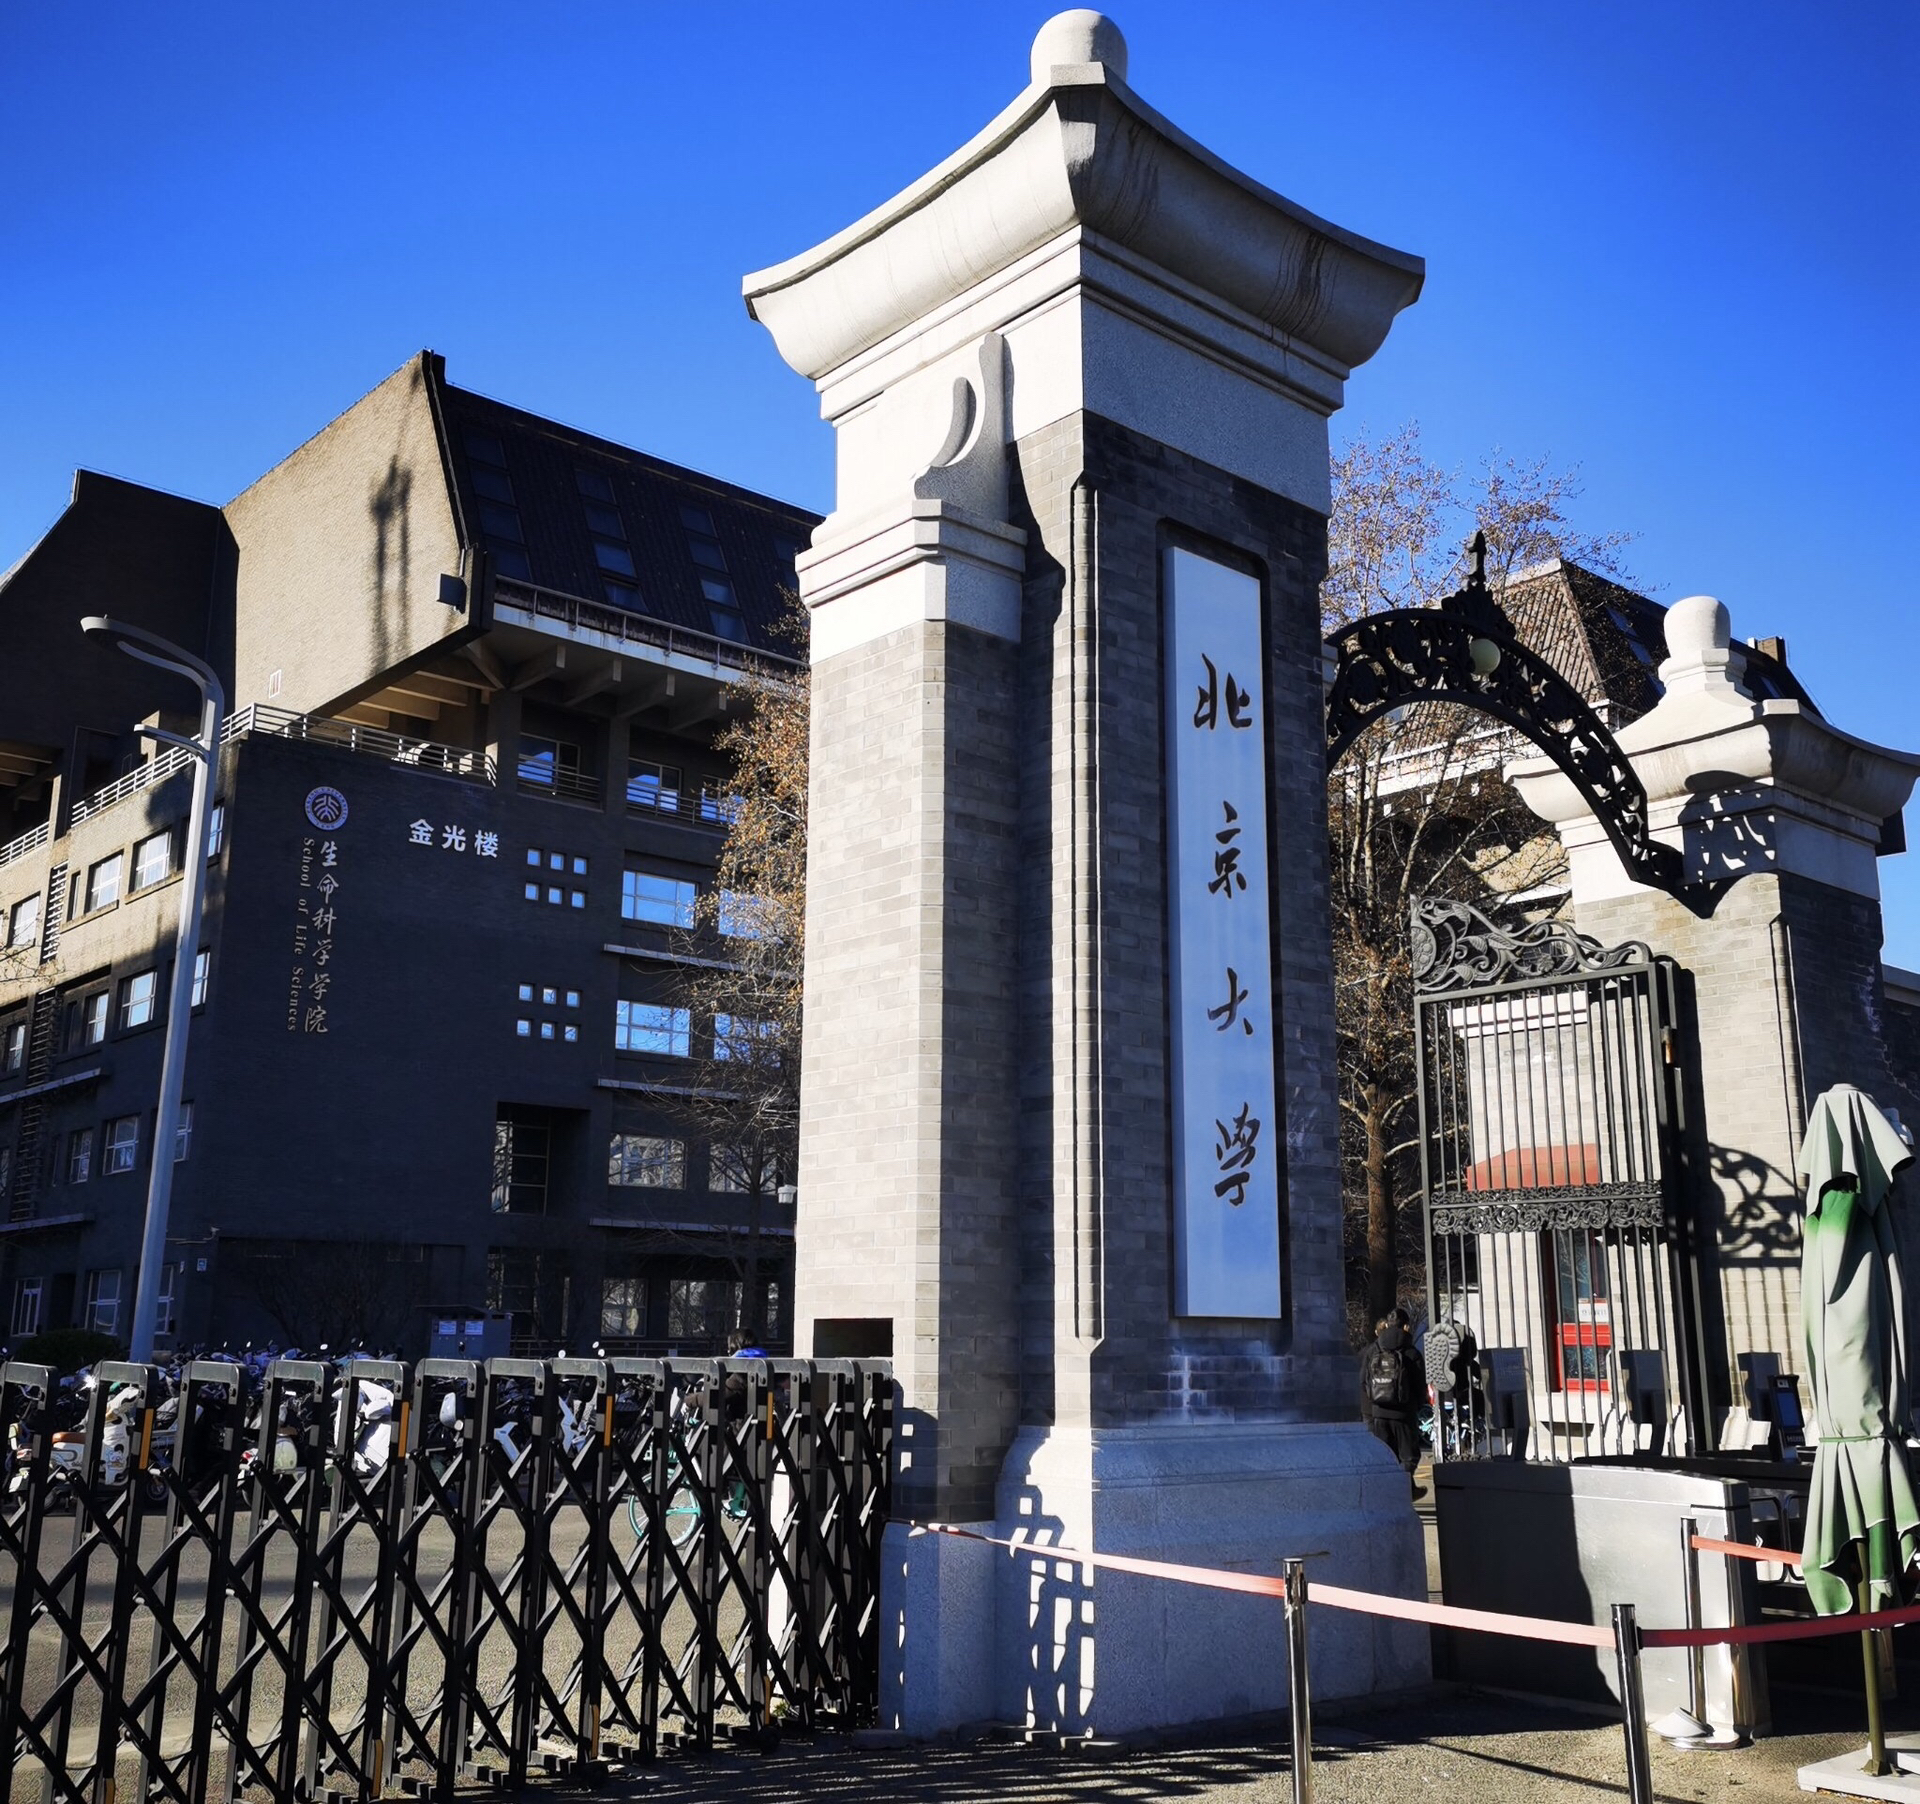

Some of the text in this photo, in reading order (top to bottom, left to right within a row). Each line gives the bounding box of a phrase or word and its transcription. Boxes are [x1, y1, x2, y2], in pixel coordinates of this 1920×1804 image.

[287, 838, 315, 1031] School of Life Sciences
[409, 819, 499, 858] 金光楼
[304, 841, 339, 1033] 生命科学学院
